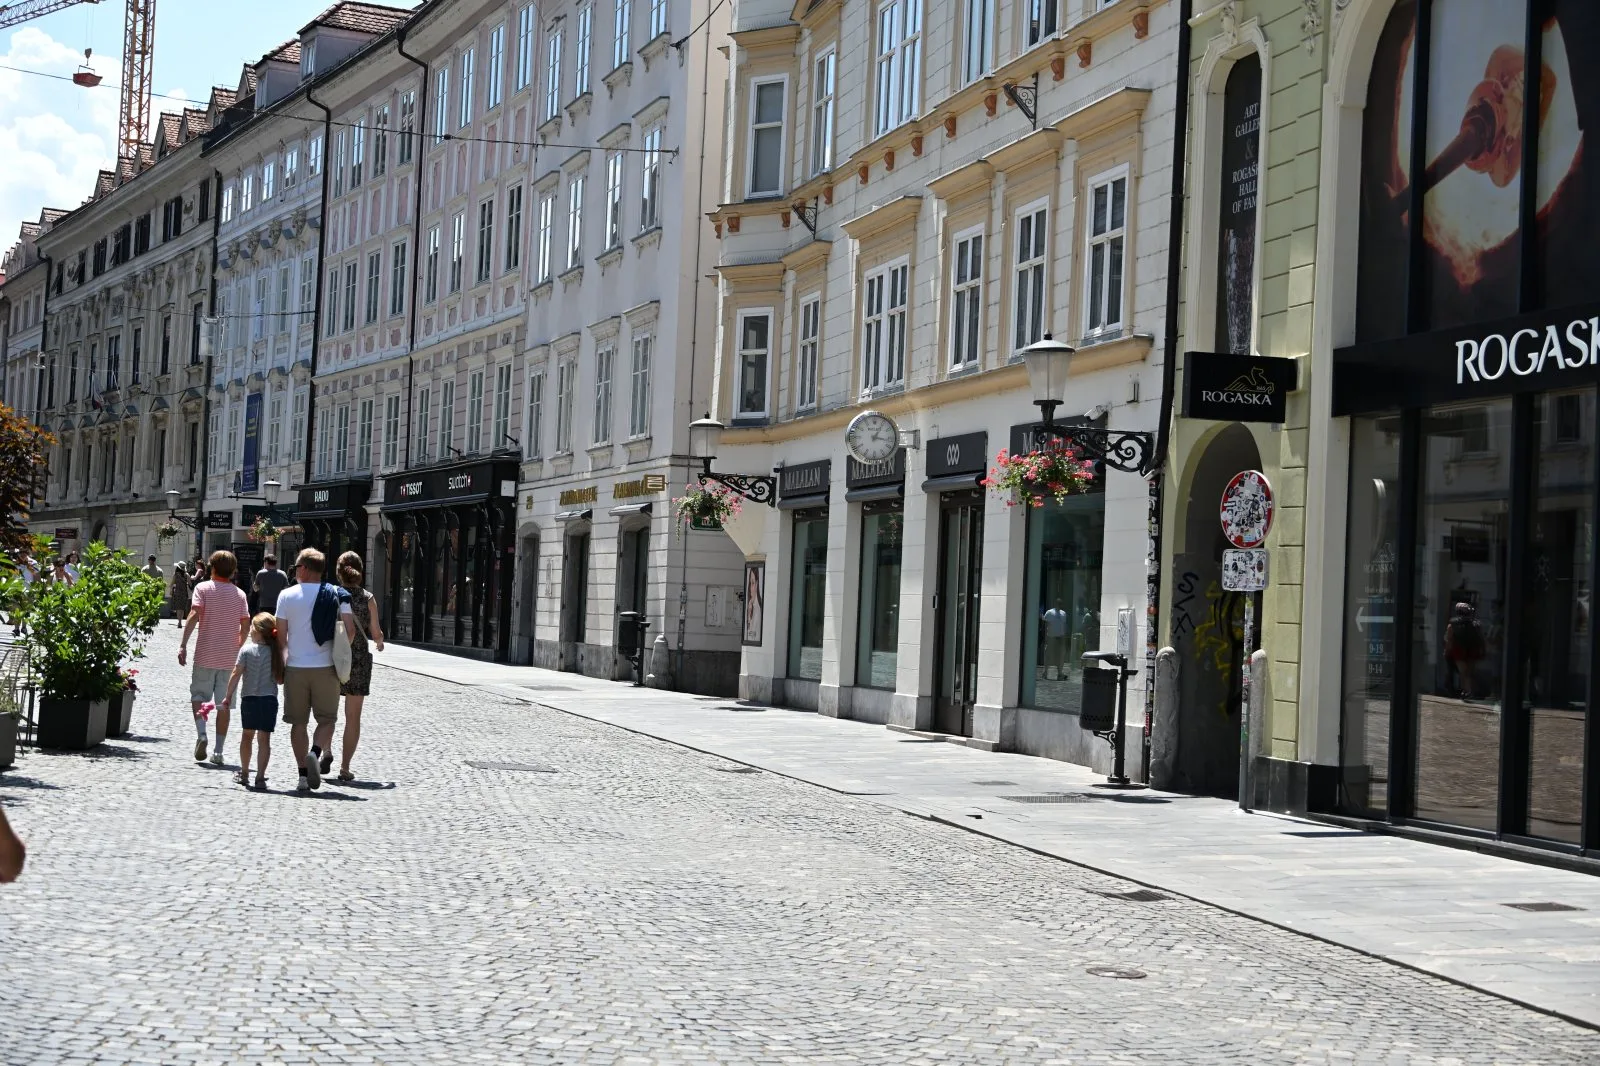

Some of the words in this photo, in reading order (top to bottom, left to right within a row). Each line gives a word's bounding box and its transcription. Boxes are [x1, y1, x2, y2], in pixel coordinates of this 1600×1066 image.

[1244, 103, 1259, 119] ART
[1245, 138, 1255, 160] &
[1238, 180, 1257, 197] HALL
[1232, 200, 1241, 214] OF
[1202, 390, 1272, 406] ROGASKA
[448, 473, 467, 490] swatch
[784, 466, 821, 491] MALALAN
[406, 481, 423, 495] TISSOT
[314, 490, 329, 503] RADO
